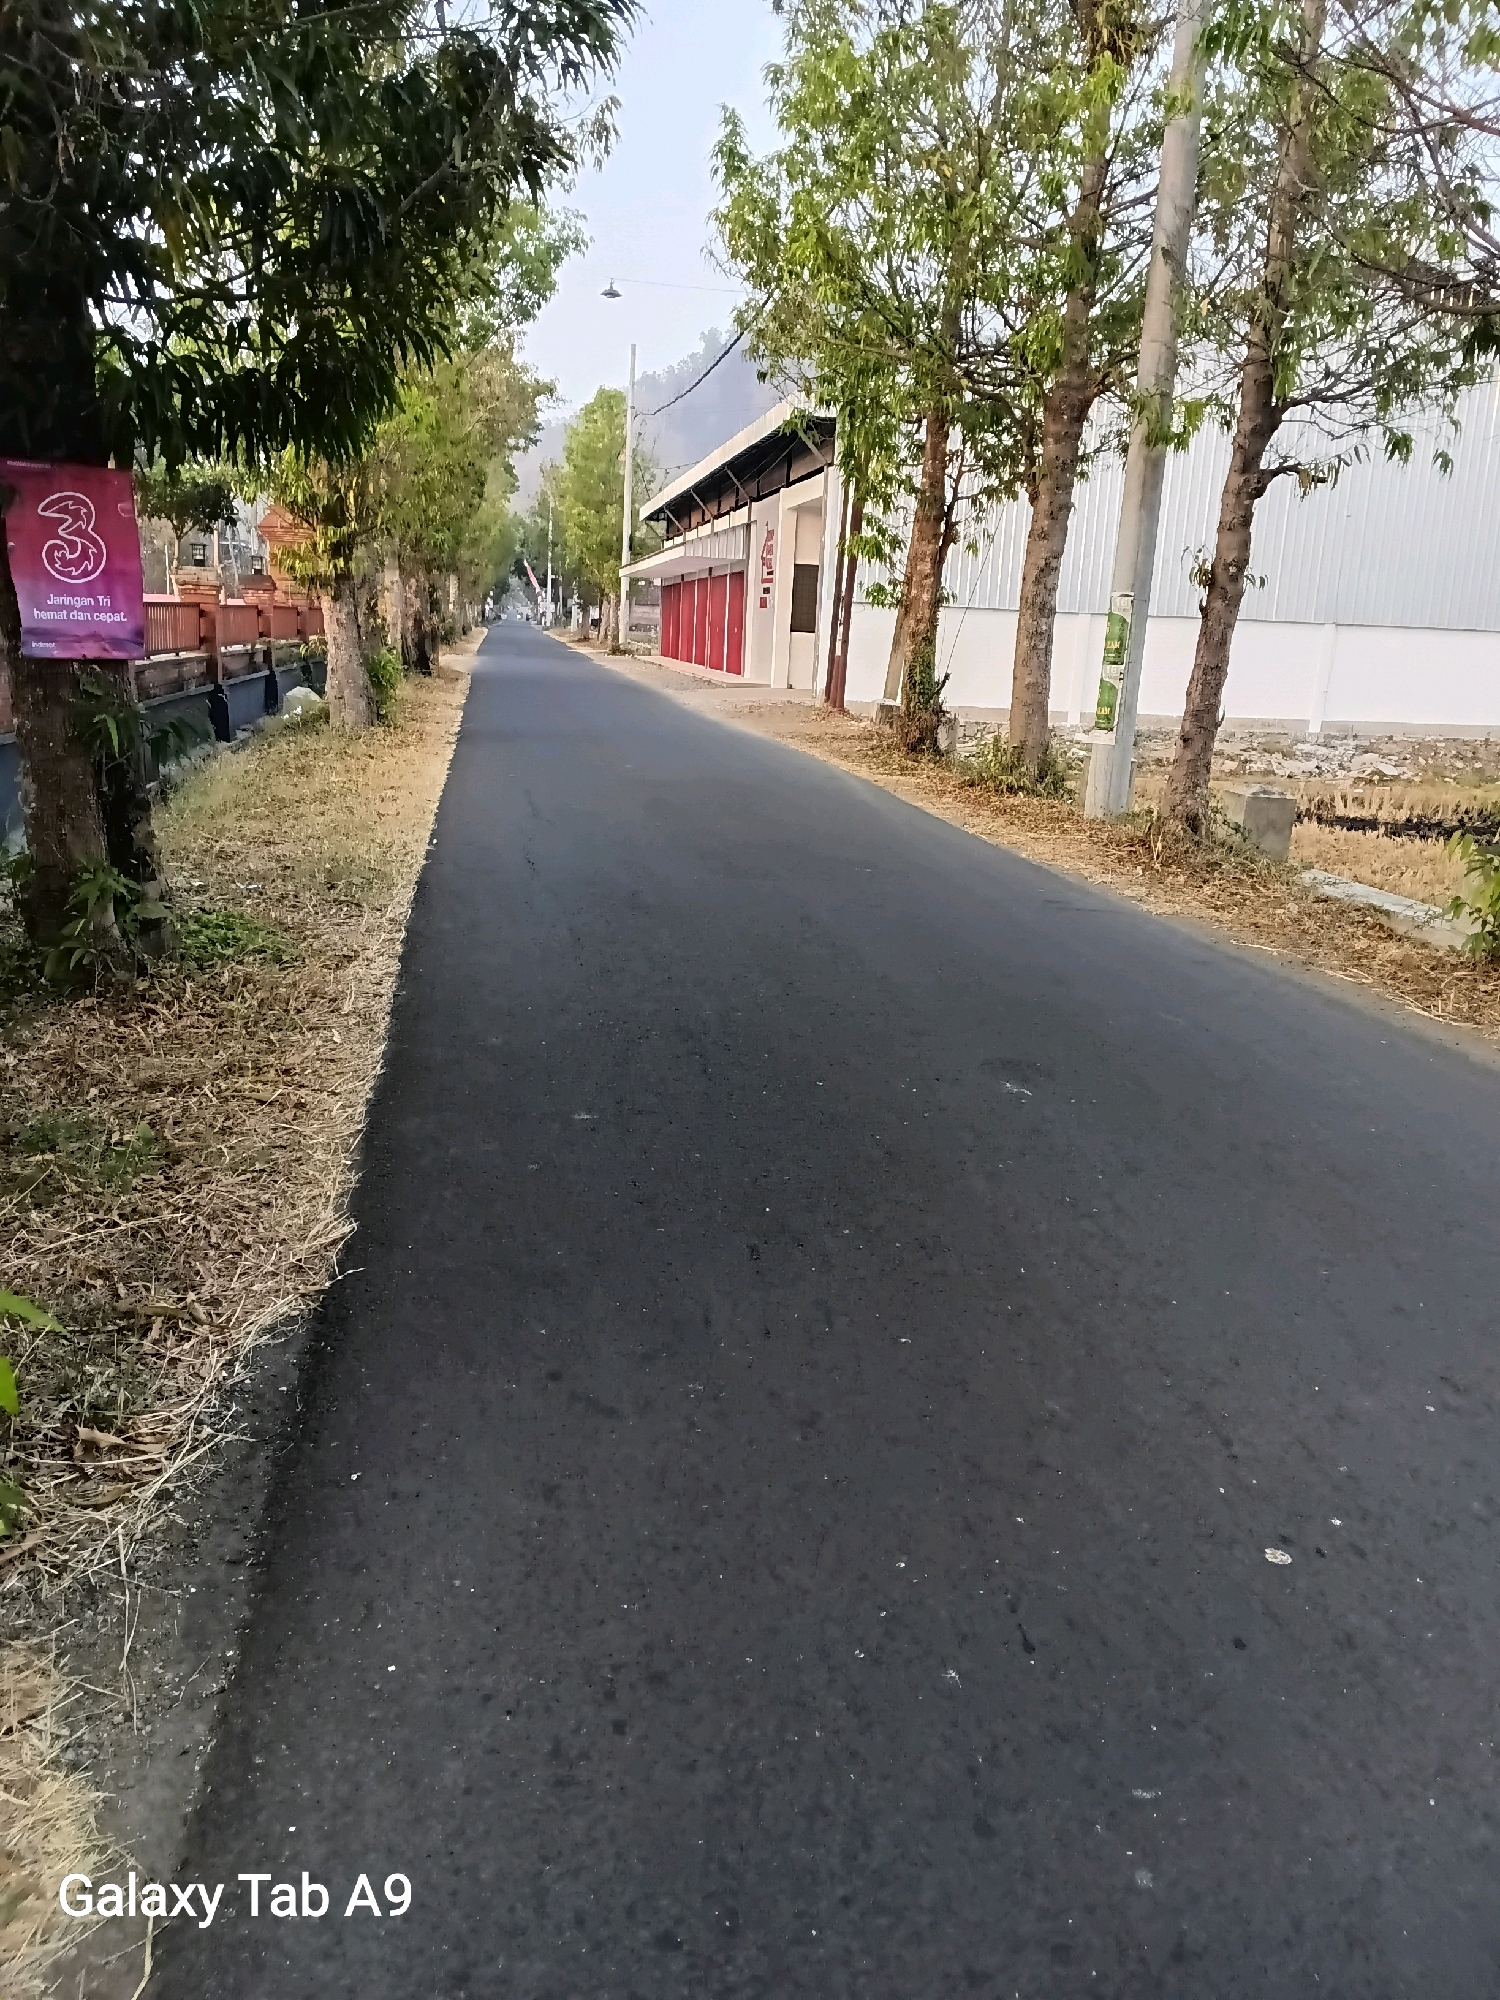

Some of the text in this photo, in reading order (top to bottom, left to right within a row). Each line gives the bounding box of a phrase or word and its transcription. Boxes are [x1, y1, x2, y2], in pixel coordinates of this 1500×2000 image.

[47, 594, 111, 608] Jaringan Tri
[33, 608, 127, 624] hemat dan cepat.
